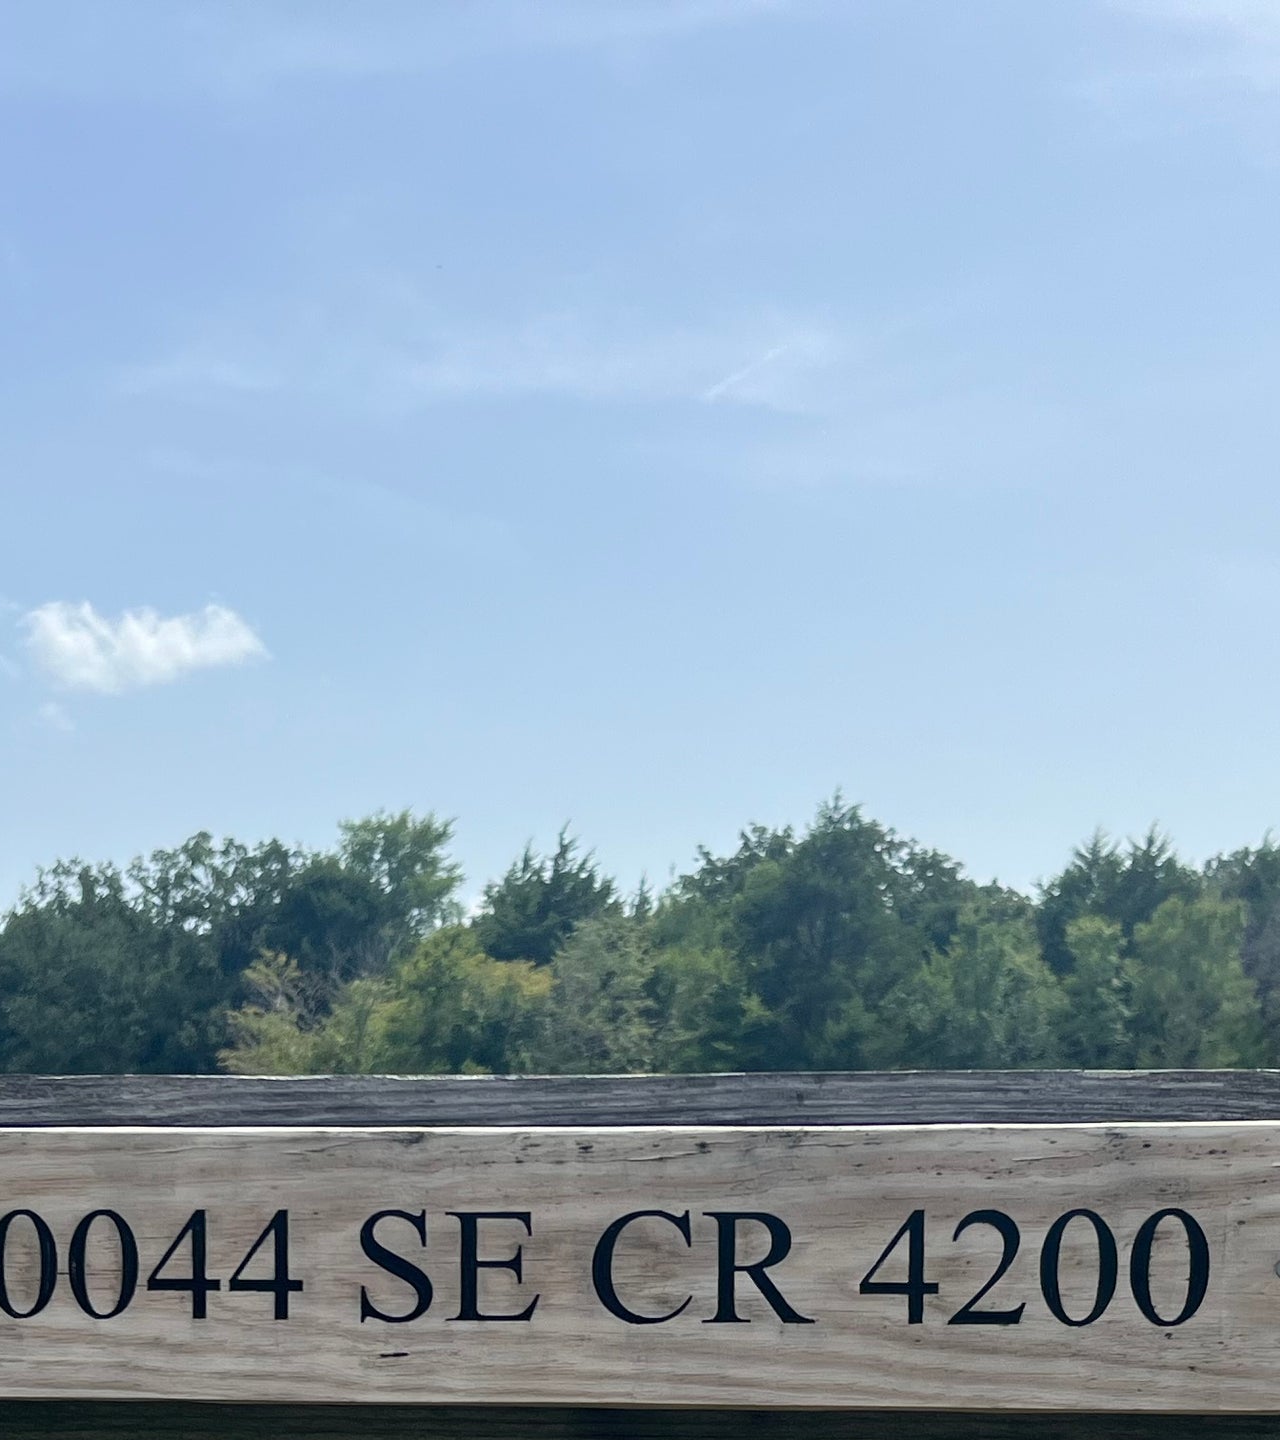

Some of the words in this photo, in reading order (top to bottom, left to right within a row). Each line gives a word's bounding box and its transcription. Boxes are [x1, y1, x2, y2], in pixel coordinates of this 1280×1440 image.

[359, 1207, 541, 1324] SE
[591, 1208, 818, 1326] CR
[859, 1206, 1211, 1328] 4200
